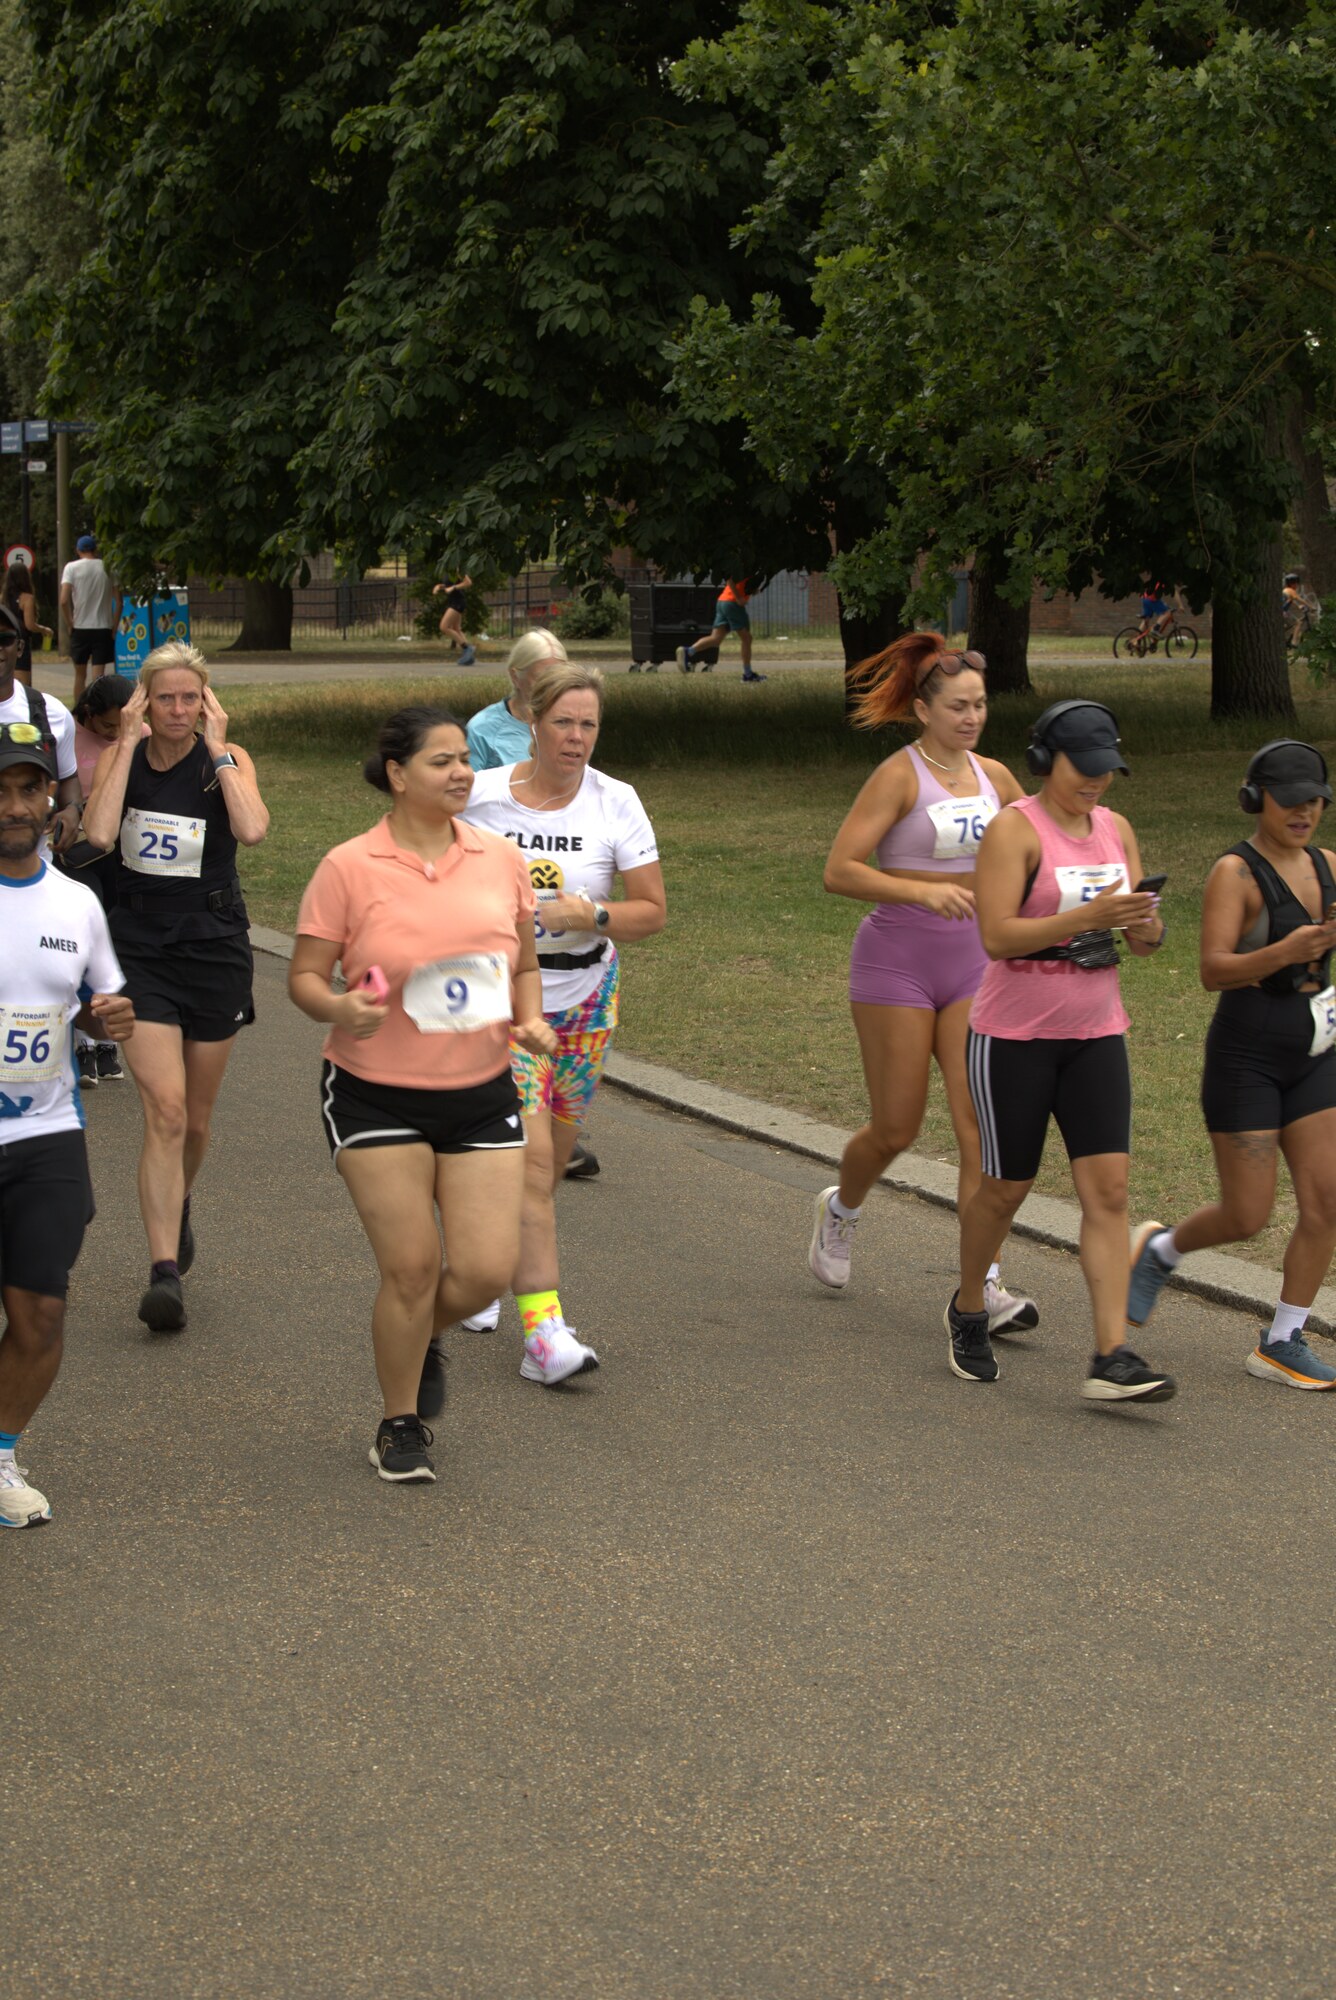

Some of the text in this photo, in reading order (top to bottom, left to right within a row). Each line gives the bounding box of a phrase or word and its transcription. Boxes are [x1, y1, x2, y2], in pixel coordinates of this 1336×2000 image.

[15, 553, 24, 565] 5
[144, 816, 180, 827] AFFORDABLE
[147, 823, 175, 833] RUNNING
[953, 814, 985, 843] 76
[138, 831, 179, 861] 25
[39, 935, 79, 954] AMEER
[444, 976, 470, 1016] 9
[11, 1012, 51, 1020] AFFORDABLE
[3, 1029, 50, 1064] 56
